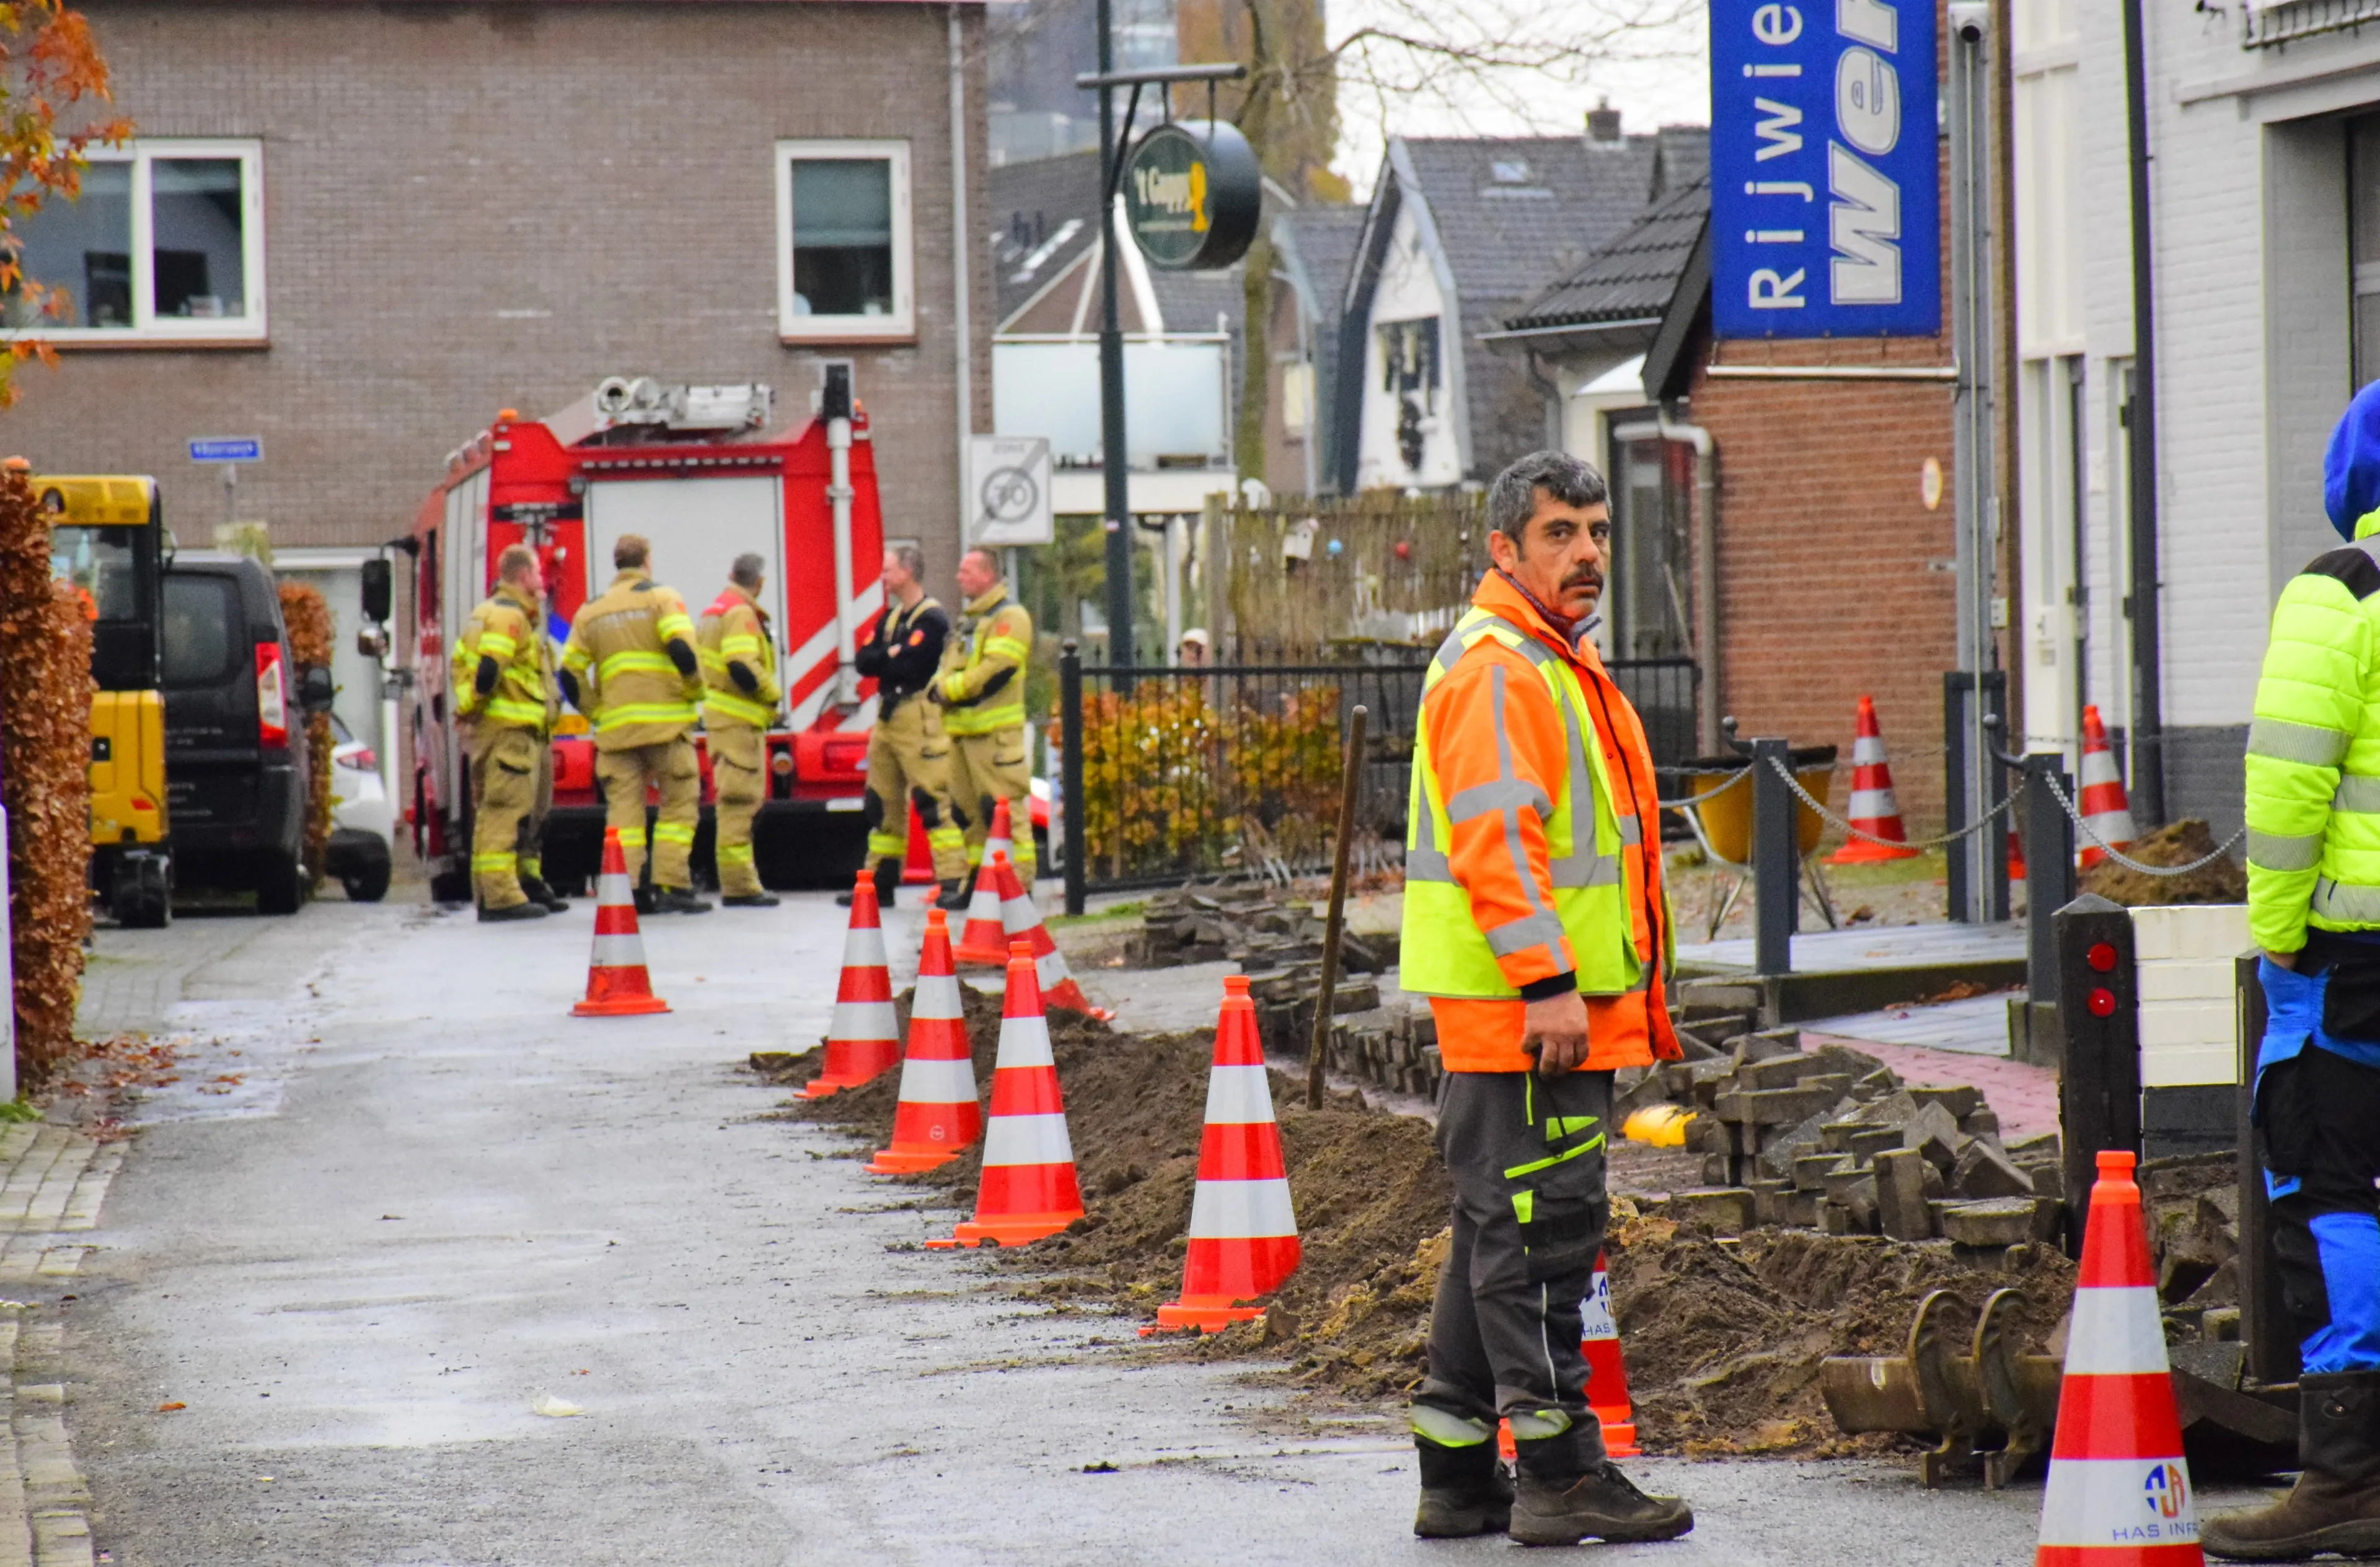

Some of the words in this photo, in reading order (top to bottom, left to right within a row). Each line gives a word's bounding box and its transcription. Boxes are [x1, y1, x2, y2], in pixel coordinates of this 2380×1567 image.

[1742, 3, 1814, 309] Rijwie
[1582, 1323, 1611, 1337] HAS
[2112, 1524, 2160, 1542] HAS
